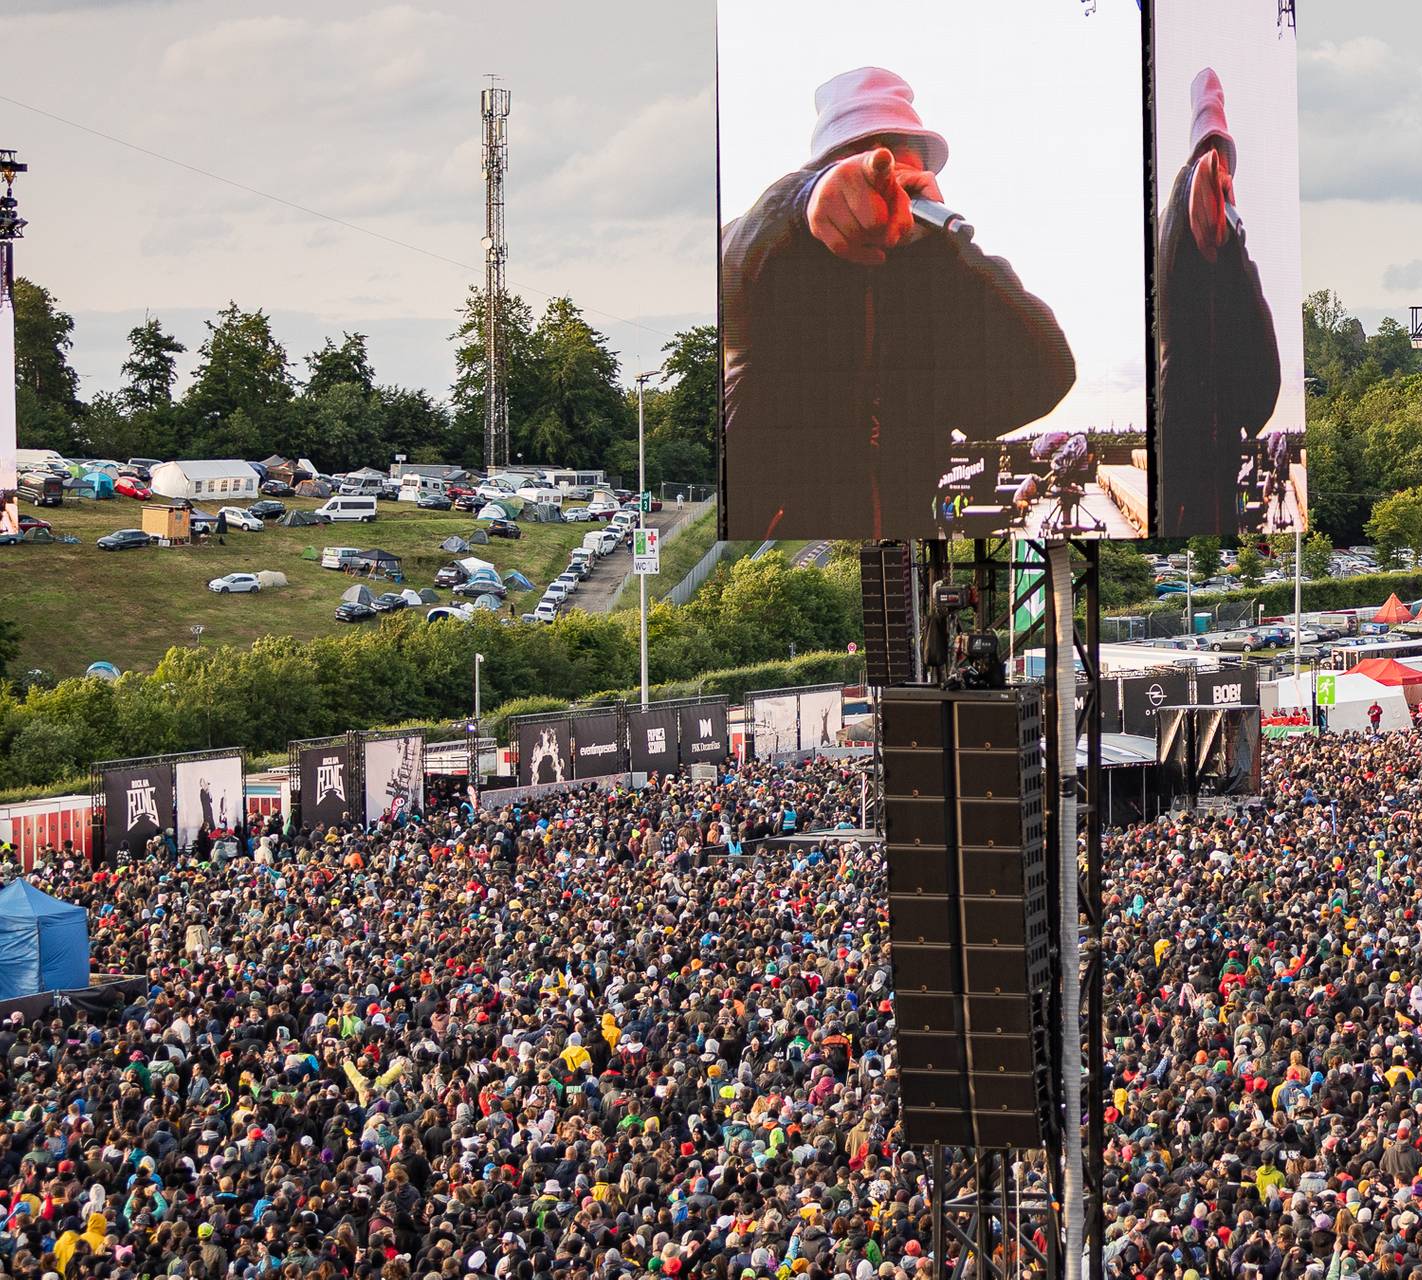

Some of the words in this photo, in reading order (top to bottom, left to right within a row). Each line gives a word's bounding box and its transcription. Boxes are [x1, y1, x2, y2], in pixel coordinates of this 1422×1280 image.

[635, 562, 647, 571] WC
[1212, 683, 1242, 704] BOB!
[316, 763, 346, 806] RING
[126, 786, 160, 832] RING
